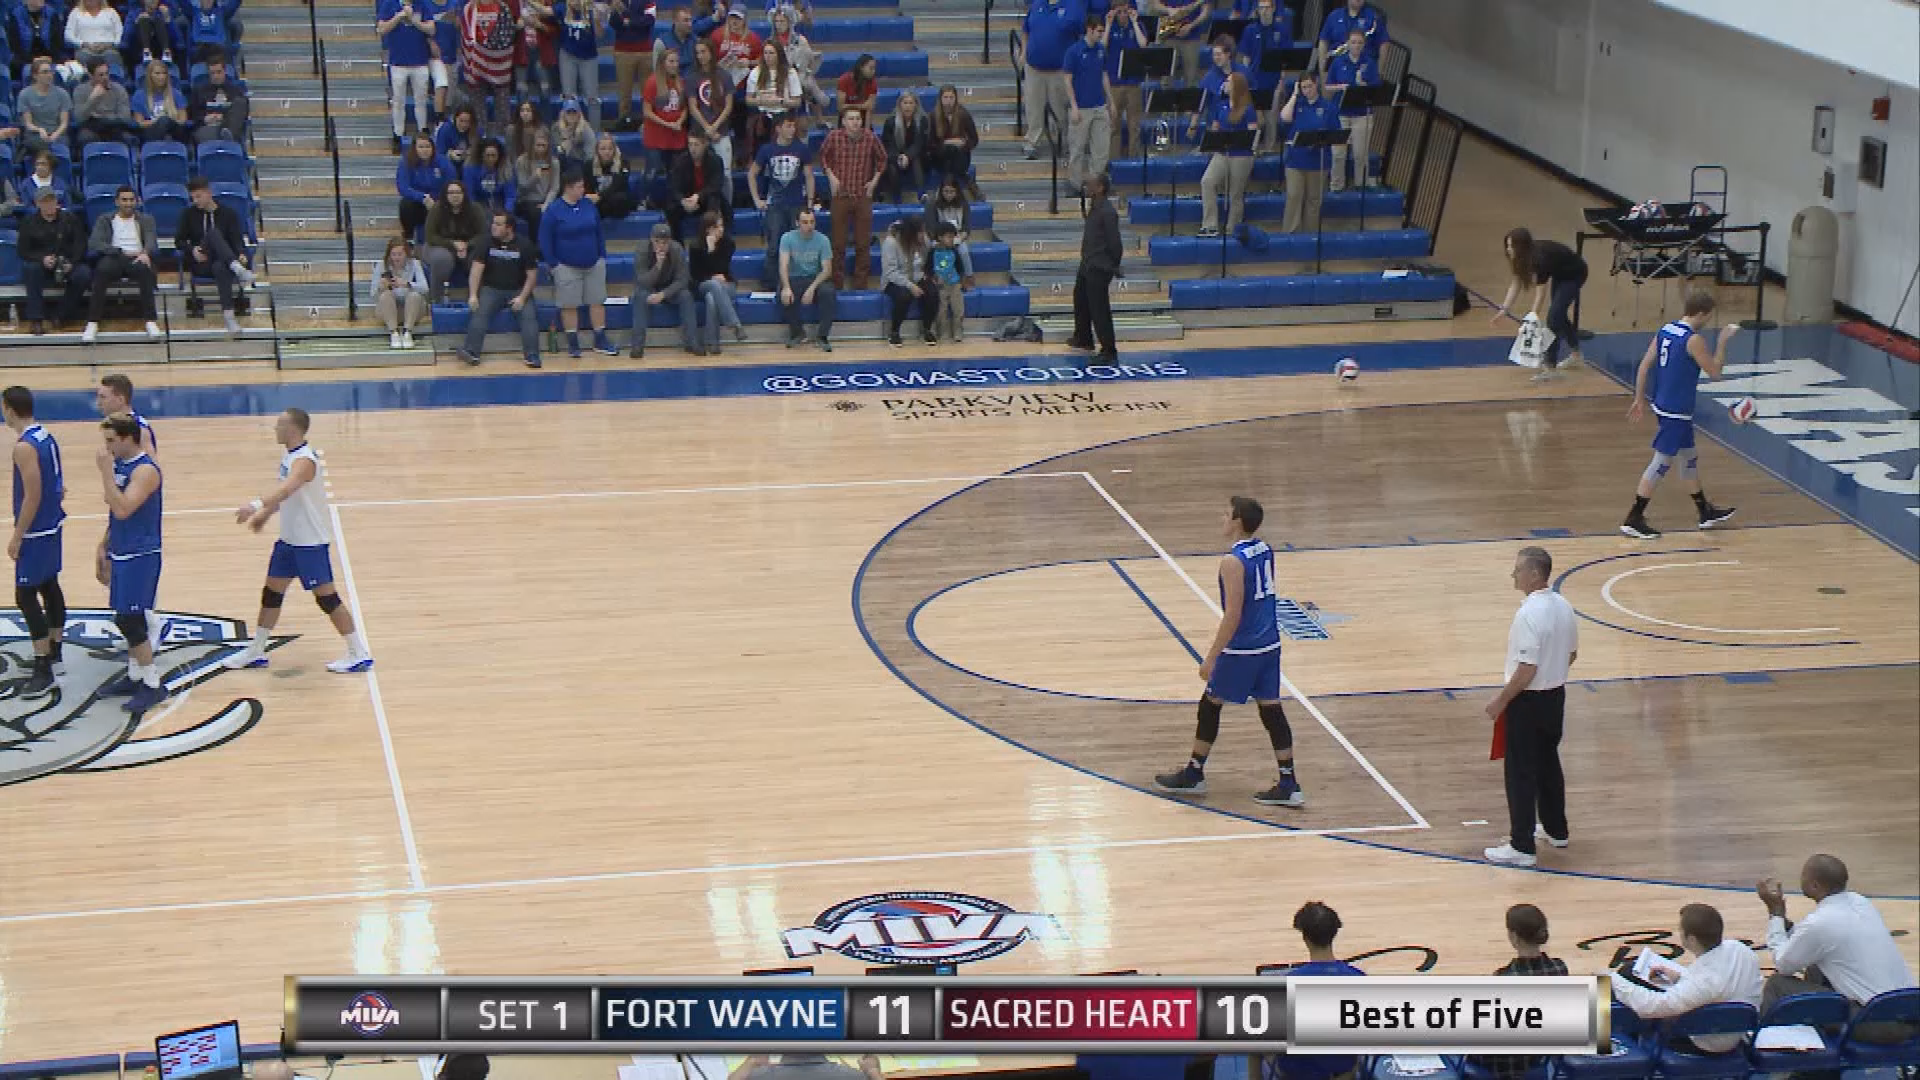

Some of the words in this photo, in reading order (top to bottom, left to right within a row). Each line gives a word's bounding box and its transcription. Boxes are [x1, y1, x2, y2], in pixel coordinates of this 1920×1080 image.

[1660, 337, 1673, 367] 5
[762, 361, 1189, 394] @GOMASTODONS
[882, 391, 1096, 411] PARKVIEW
[892, 407, 1012, 421] SPORTS
[782, 911, 1070, 960] MIVA
